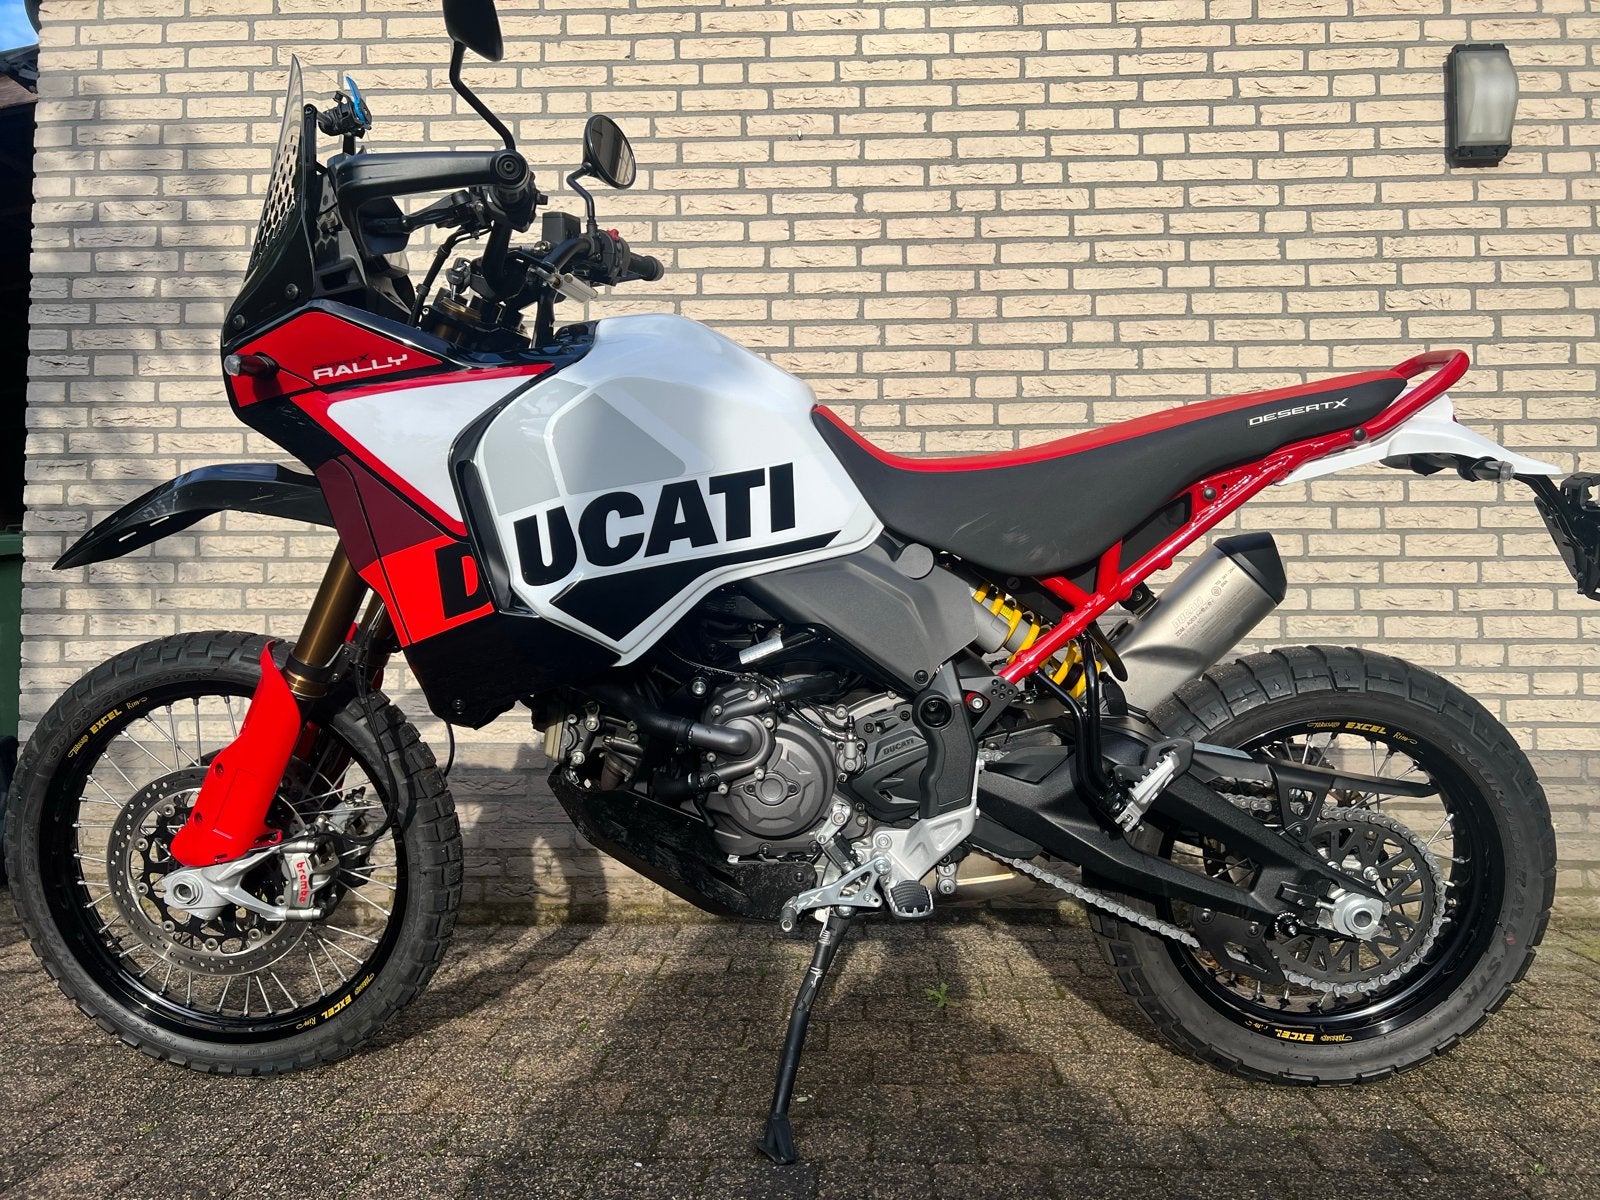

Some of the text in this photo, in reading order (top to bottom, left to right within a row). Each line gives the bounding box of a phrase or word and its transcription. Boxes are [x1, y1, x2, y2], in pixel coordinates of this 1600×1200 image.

[313, 354, 408, 380] RALLY
[1248, 397, 1349, 426] DESERTX
[89, 708, 123, 735] EXCEL
[1344, 721, 1387, 735] EXCEL
[883, 737, 914, 756] DUCATI
[296, 861, 310, 904] brembo
[321, 994, 353, 1020] EXCEL
[1274, 1028, 1315, 1042] EXCEL
